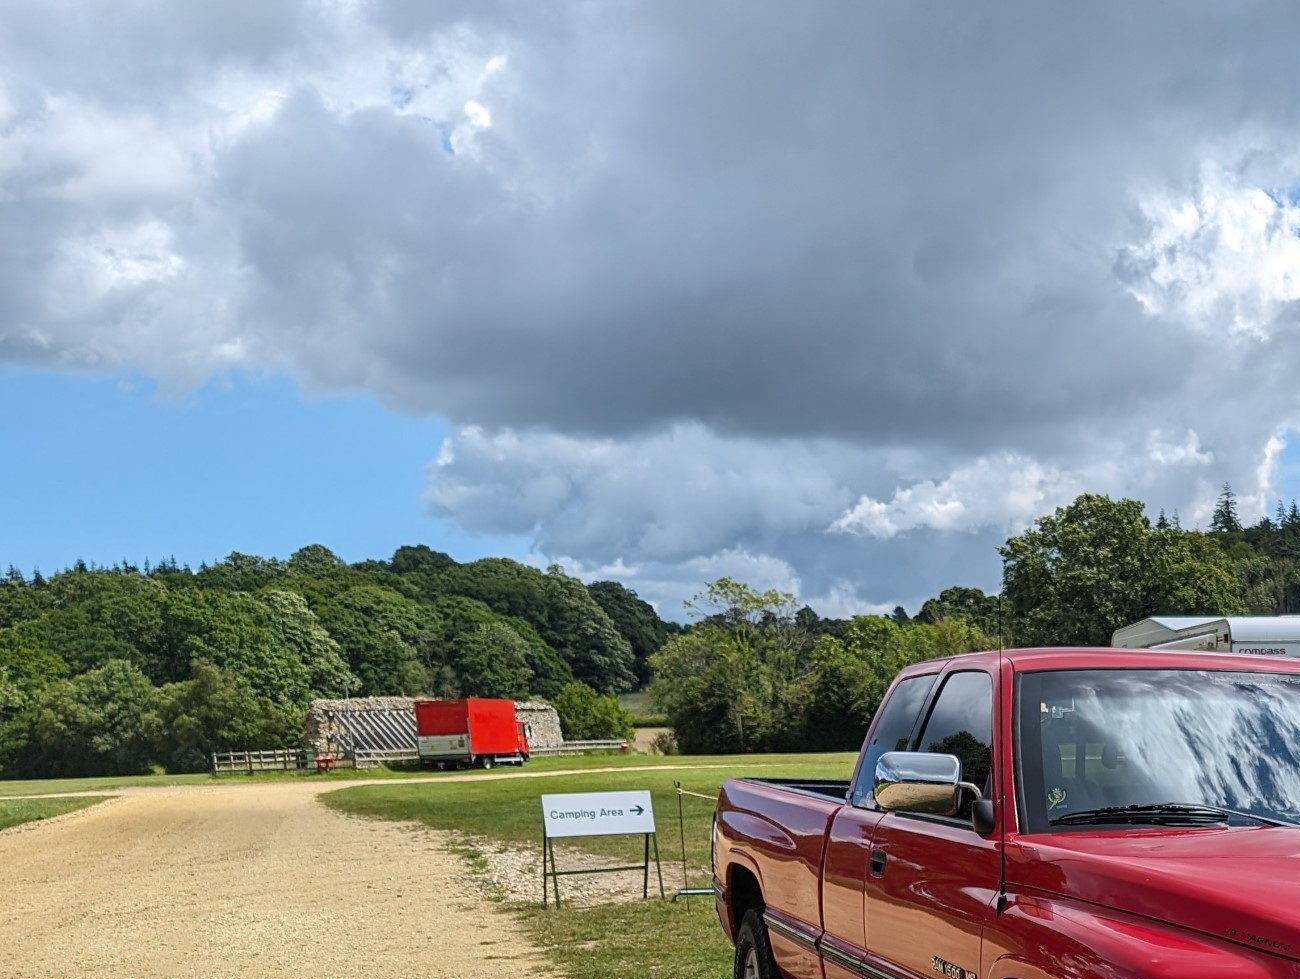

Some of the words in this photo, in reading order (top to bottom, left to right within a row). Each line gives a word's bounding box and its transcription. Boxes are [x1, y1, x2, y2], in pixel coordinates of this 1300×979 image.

[1238, 648, 1286, 656] compass
[549, 809, 596, 820] Camping
[599, 807, 624, 817] Area
[1240, 931, 1291, 952] MAGNUM
